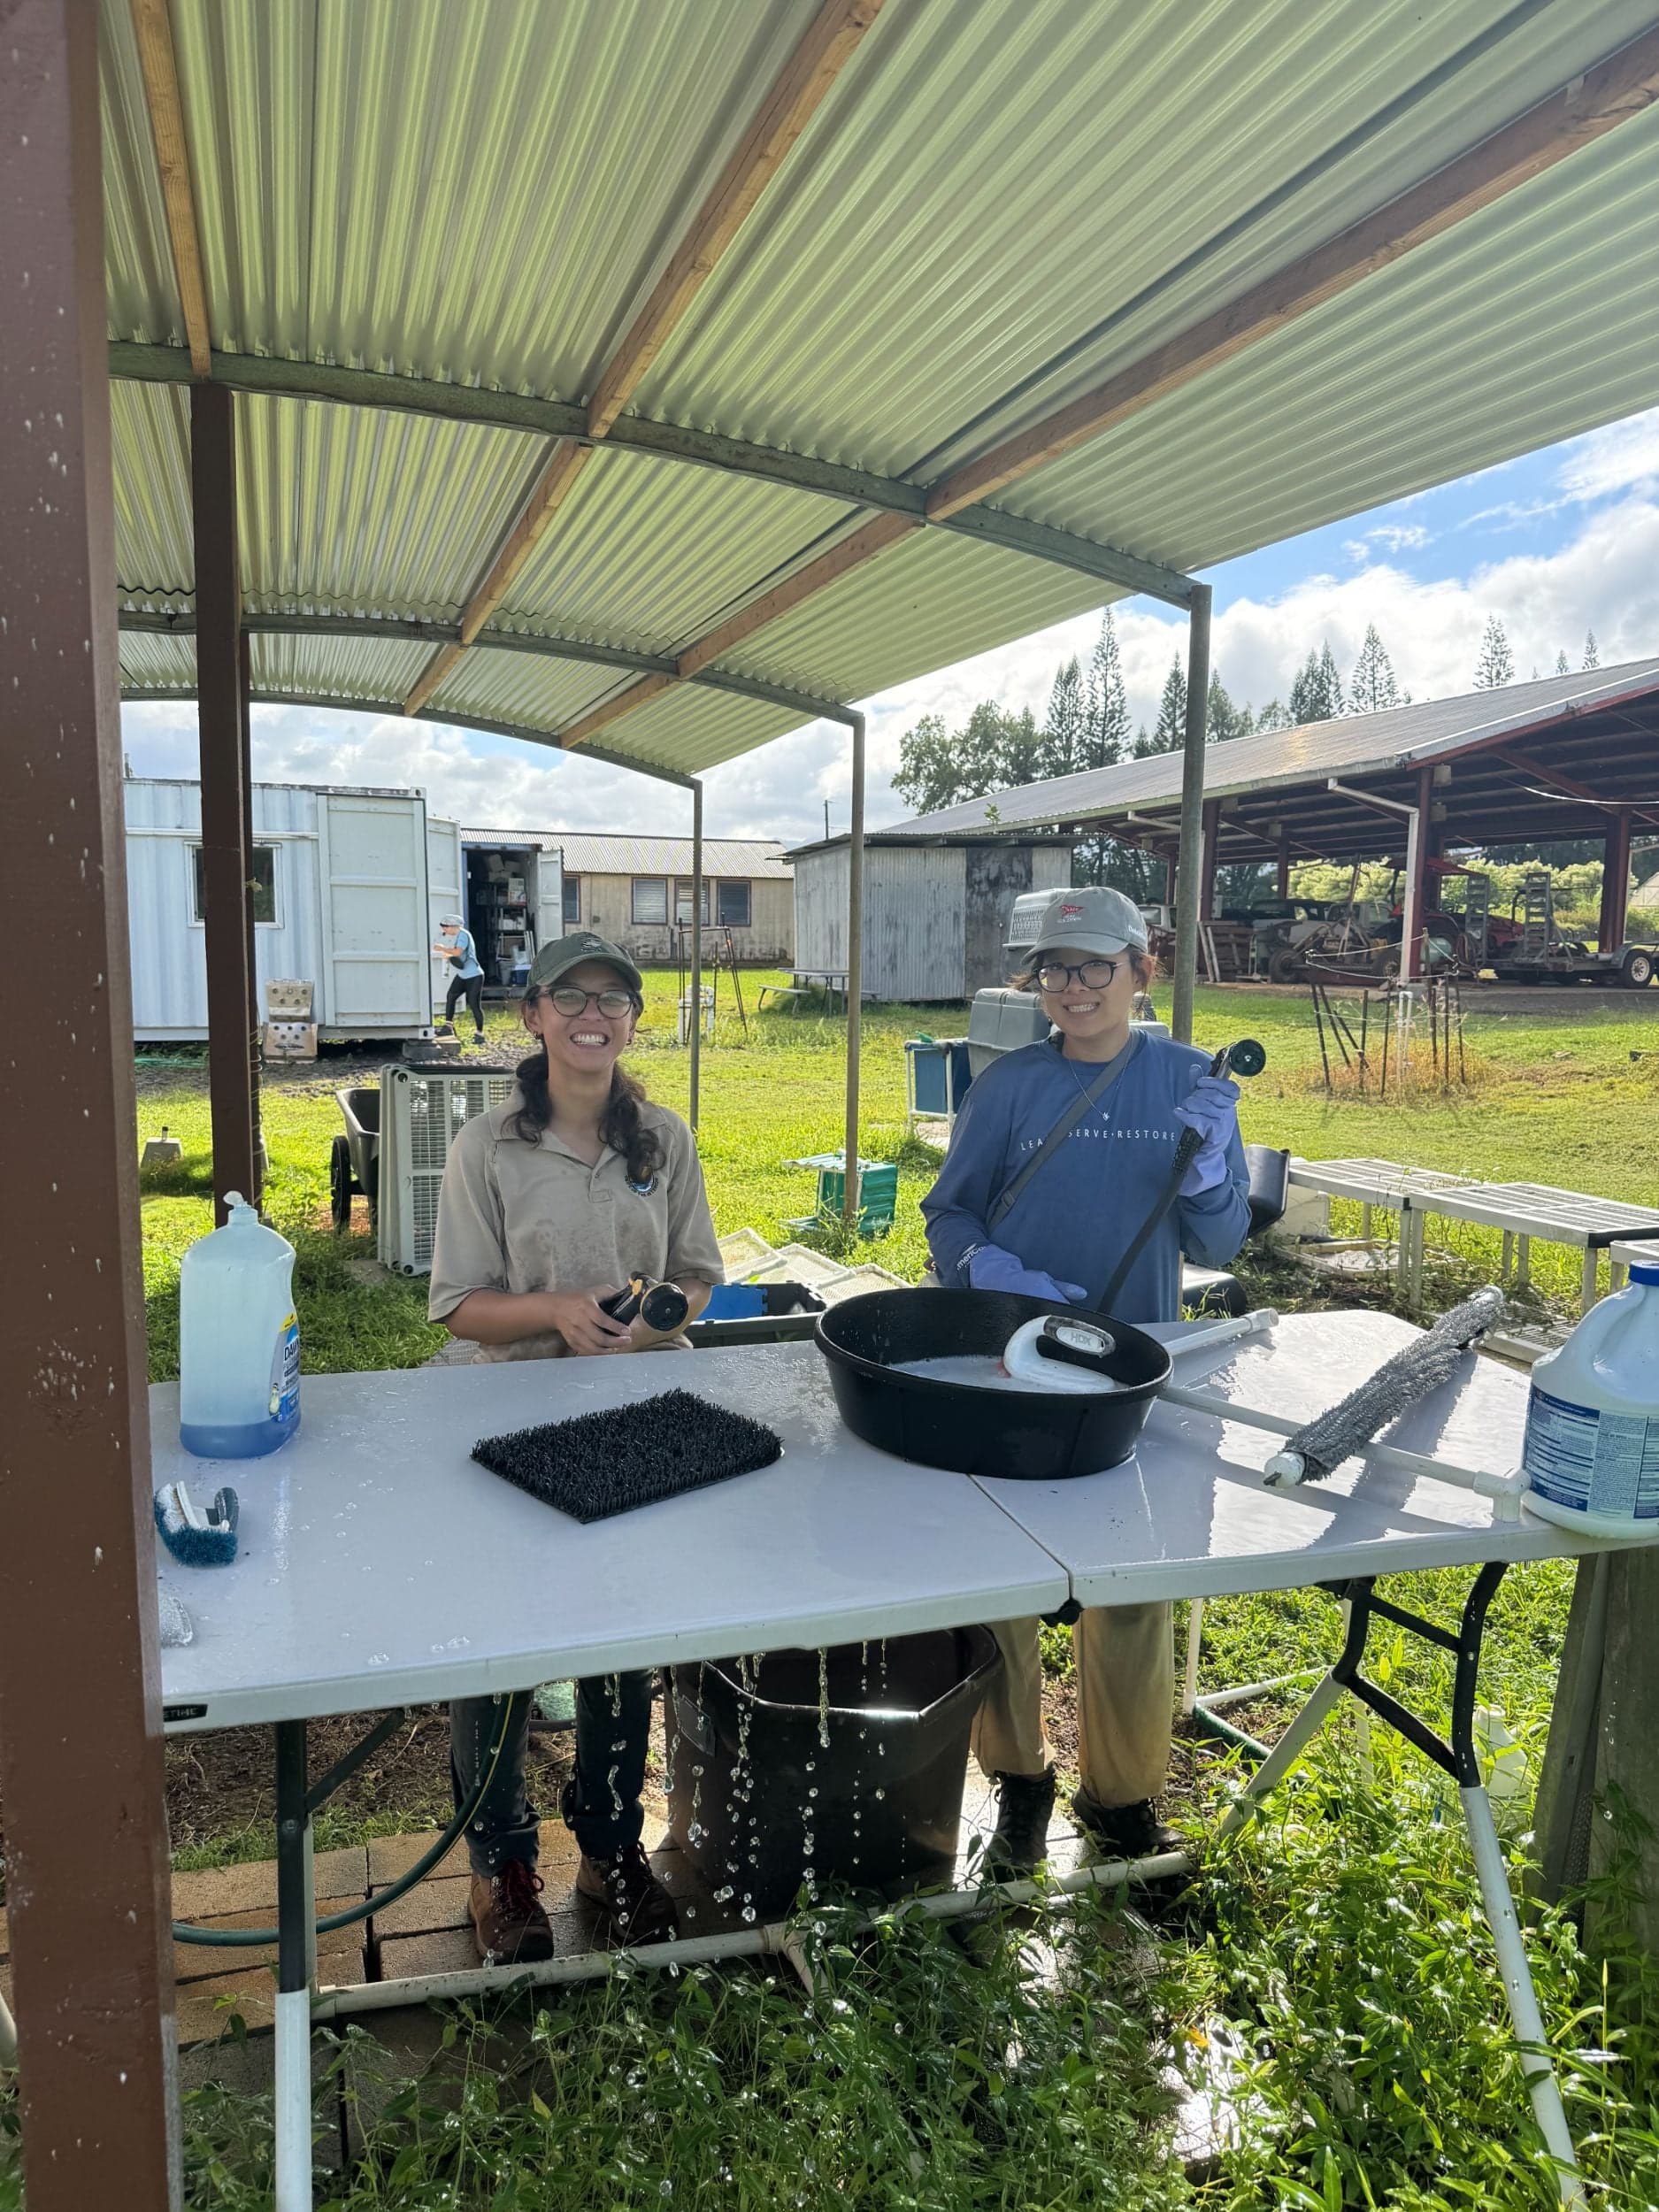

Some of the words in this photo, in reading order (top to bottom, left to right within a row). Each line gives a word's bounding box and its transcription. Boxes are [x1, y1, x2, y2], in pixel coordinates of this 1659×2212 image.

[1020, 1138, 1047, 1150] LEA
[956, 1246, 987, 1271] meriCo
[163, 1708, 199, 1718] ETIME
